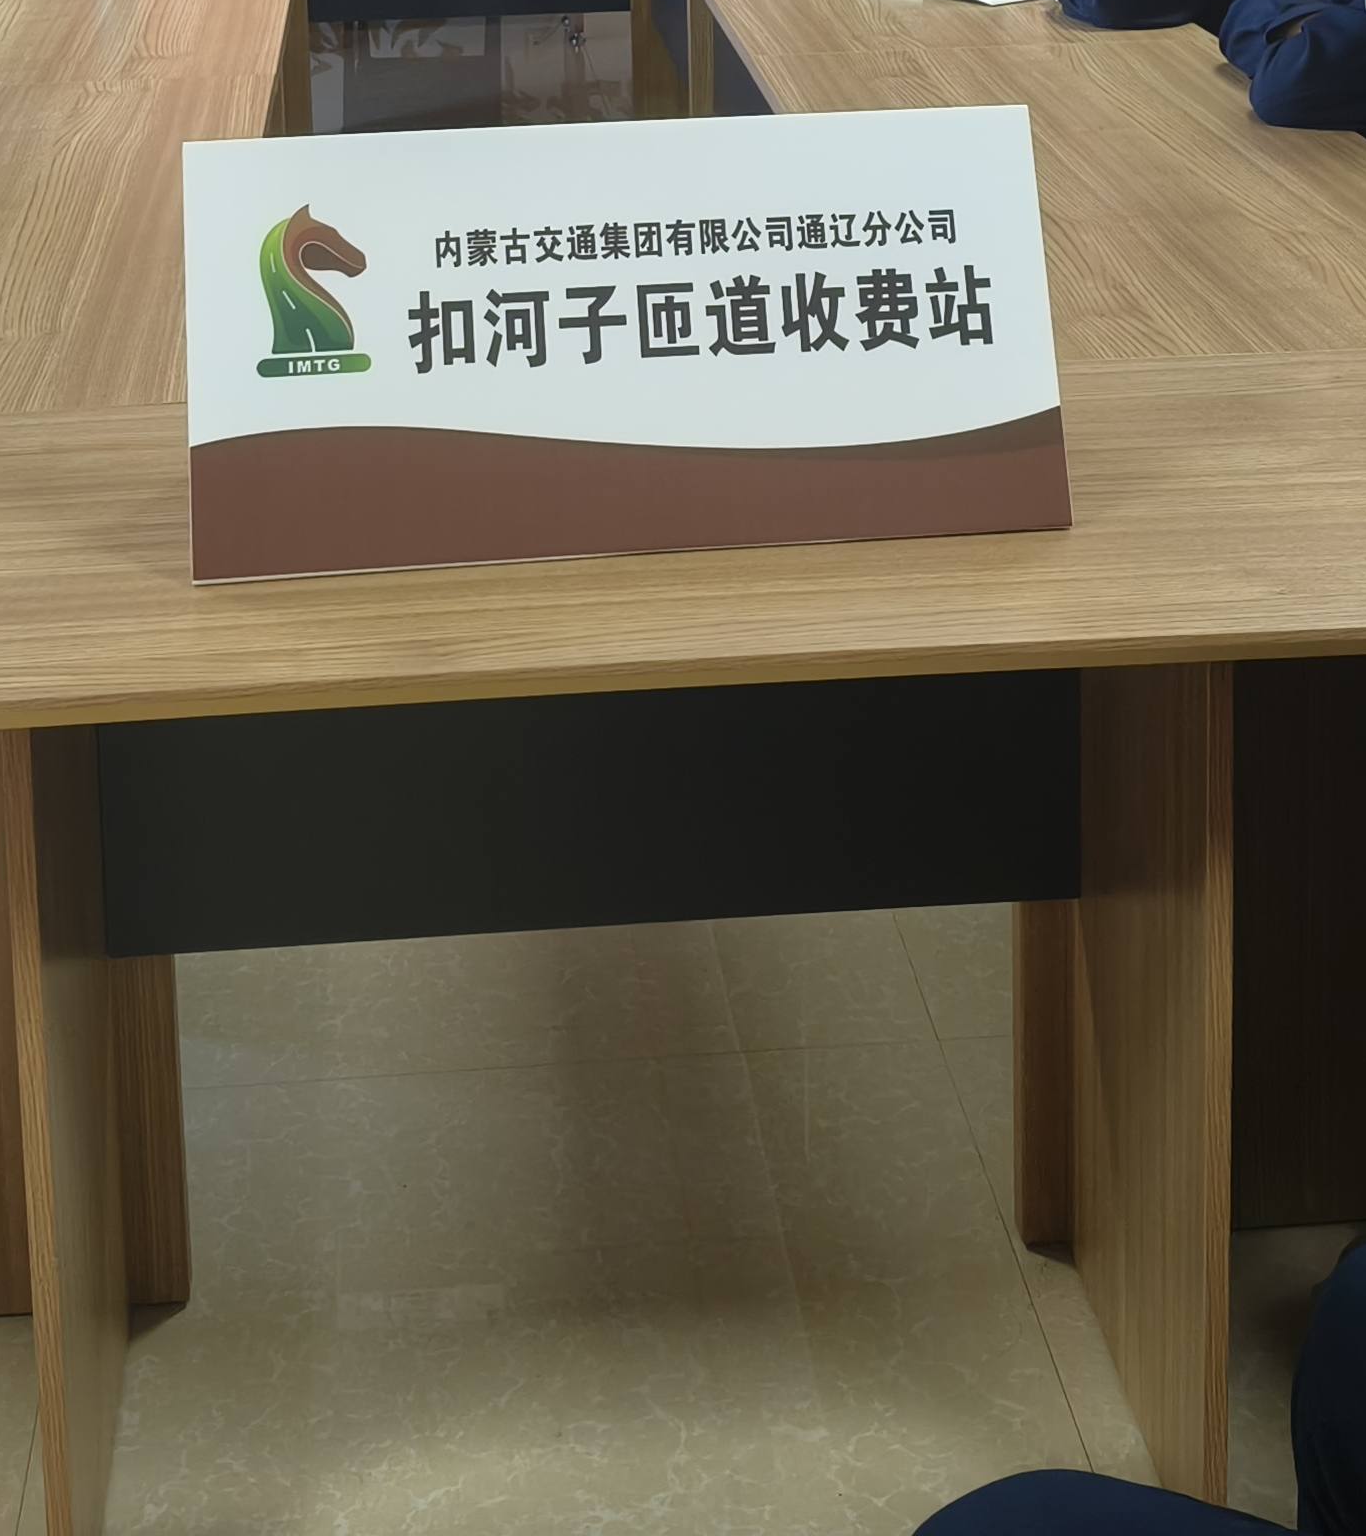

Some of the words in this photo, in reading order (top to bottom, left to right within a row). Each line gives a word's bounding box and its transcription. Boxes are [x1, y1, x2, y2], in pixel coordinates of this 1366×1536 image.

[434, 208, 958, 269] 内蒙古交通集团有限公司通辽分公司
[407, 265, 995, 374] 扣河子匝道收费站
[289, 359, 340, 373] IMTG
